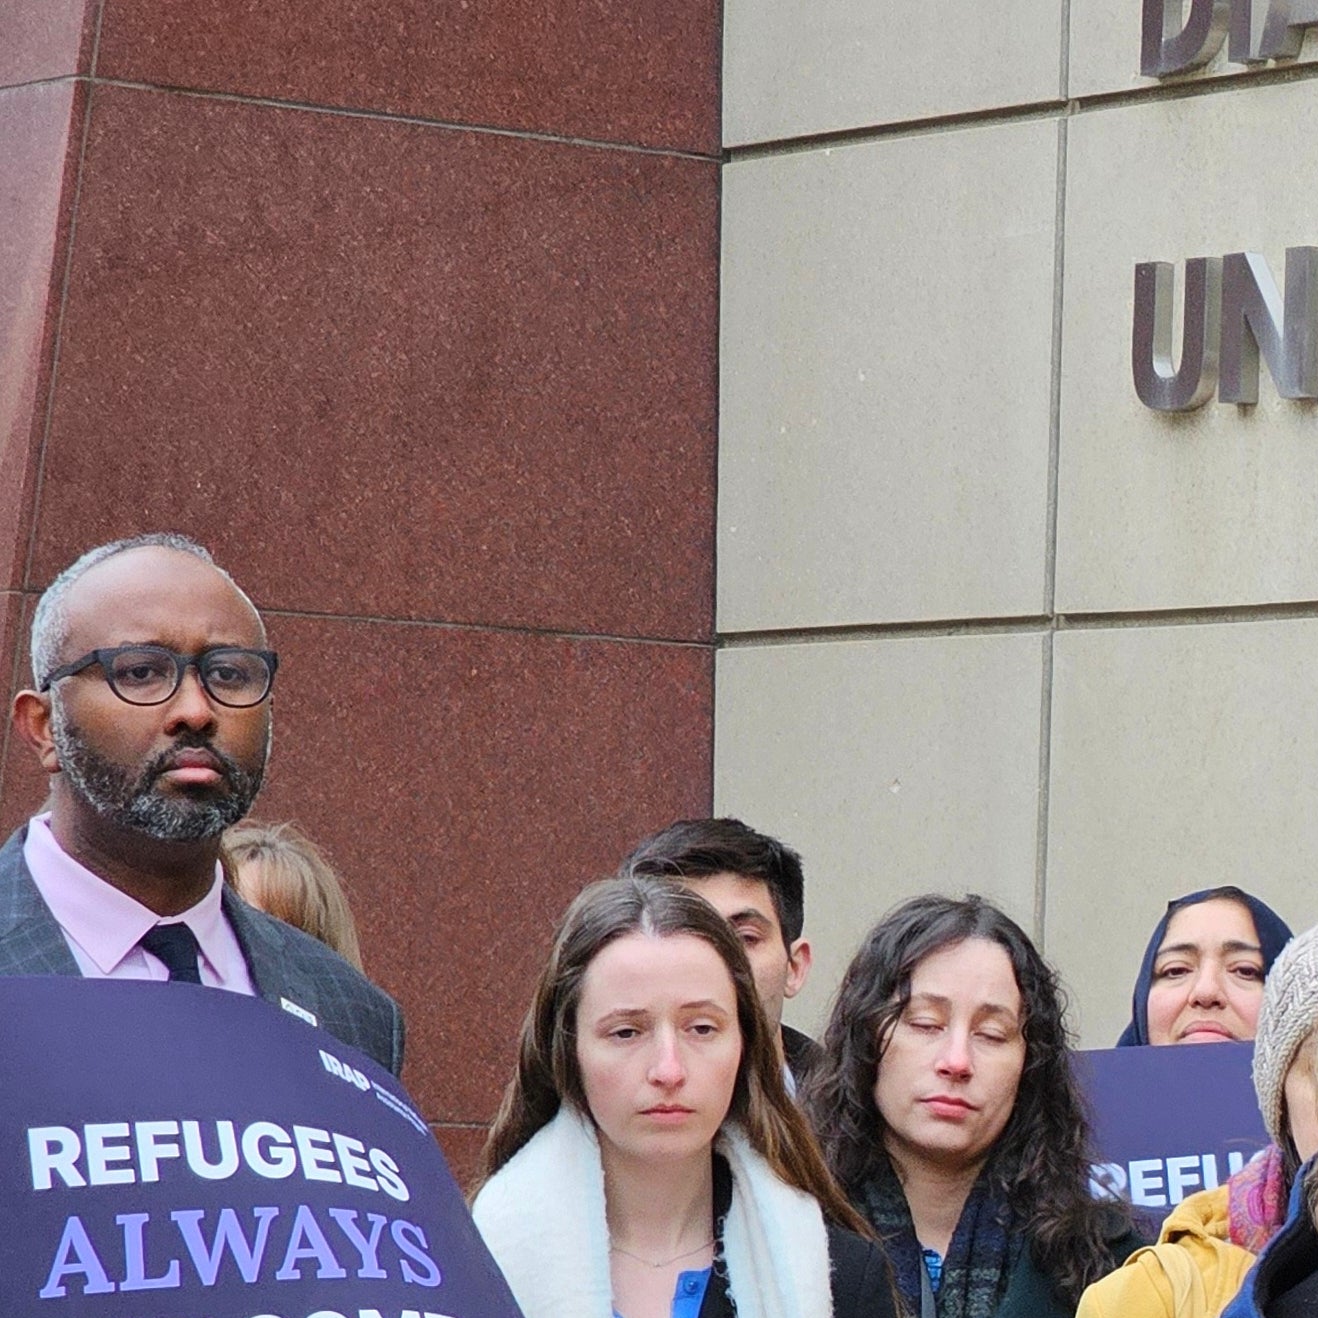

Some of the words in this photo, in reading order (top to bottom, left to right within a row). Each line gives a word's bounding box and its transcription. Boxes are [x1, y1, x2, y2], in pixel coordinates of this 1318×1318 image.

[318, 1049, 371, 1092] IRAP
[27, 1119, 410, 1202] REFUGEES
[38, 1204, 442, 1299] ALWAYS
